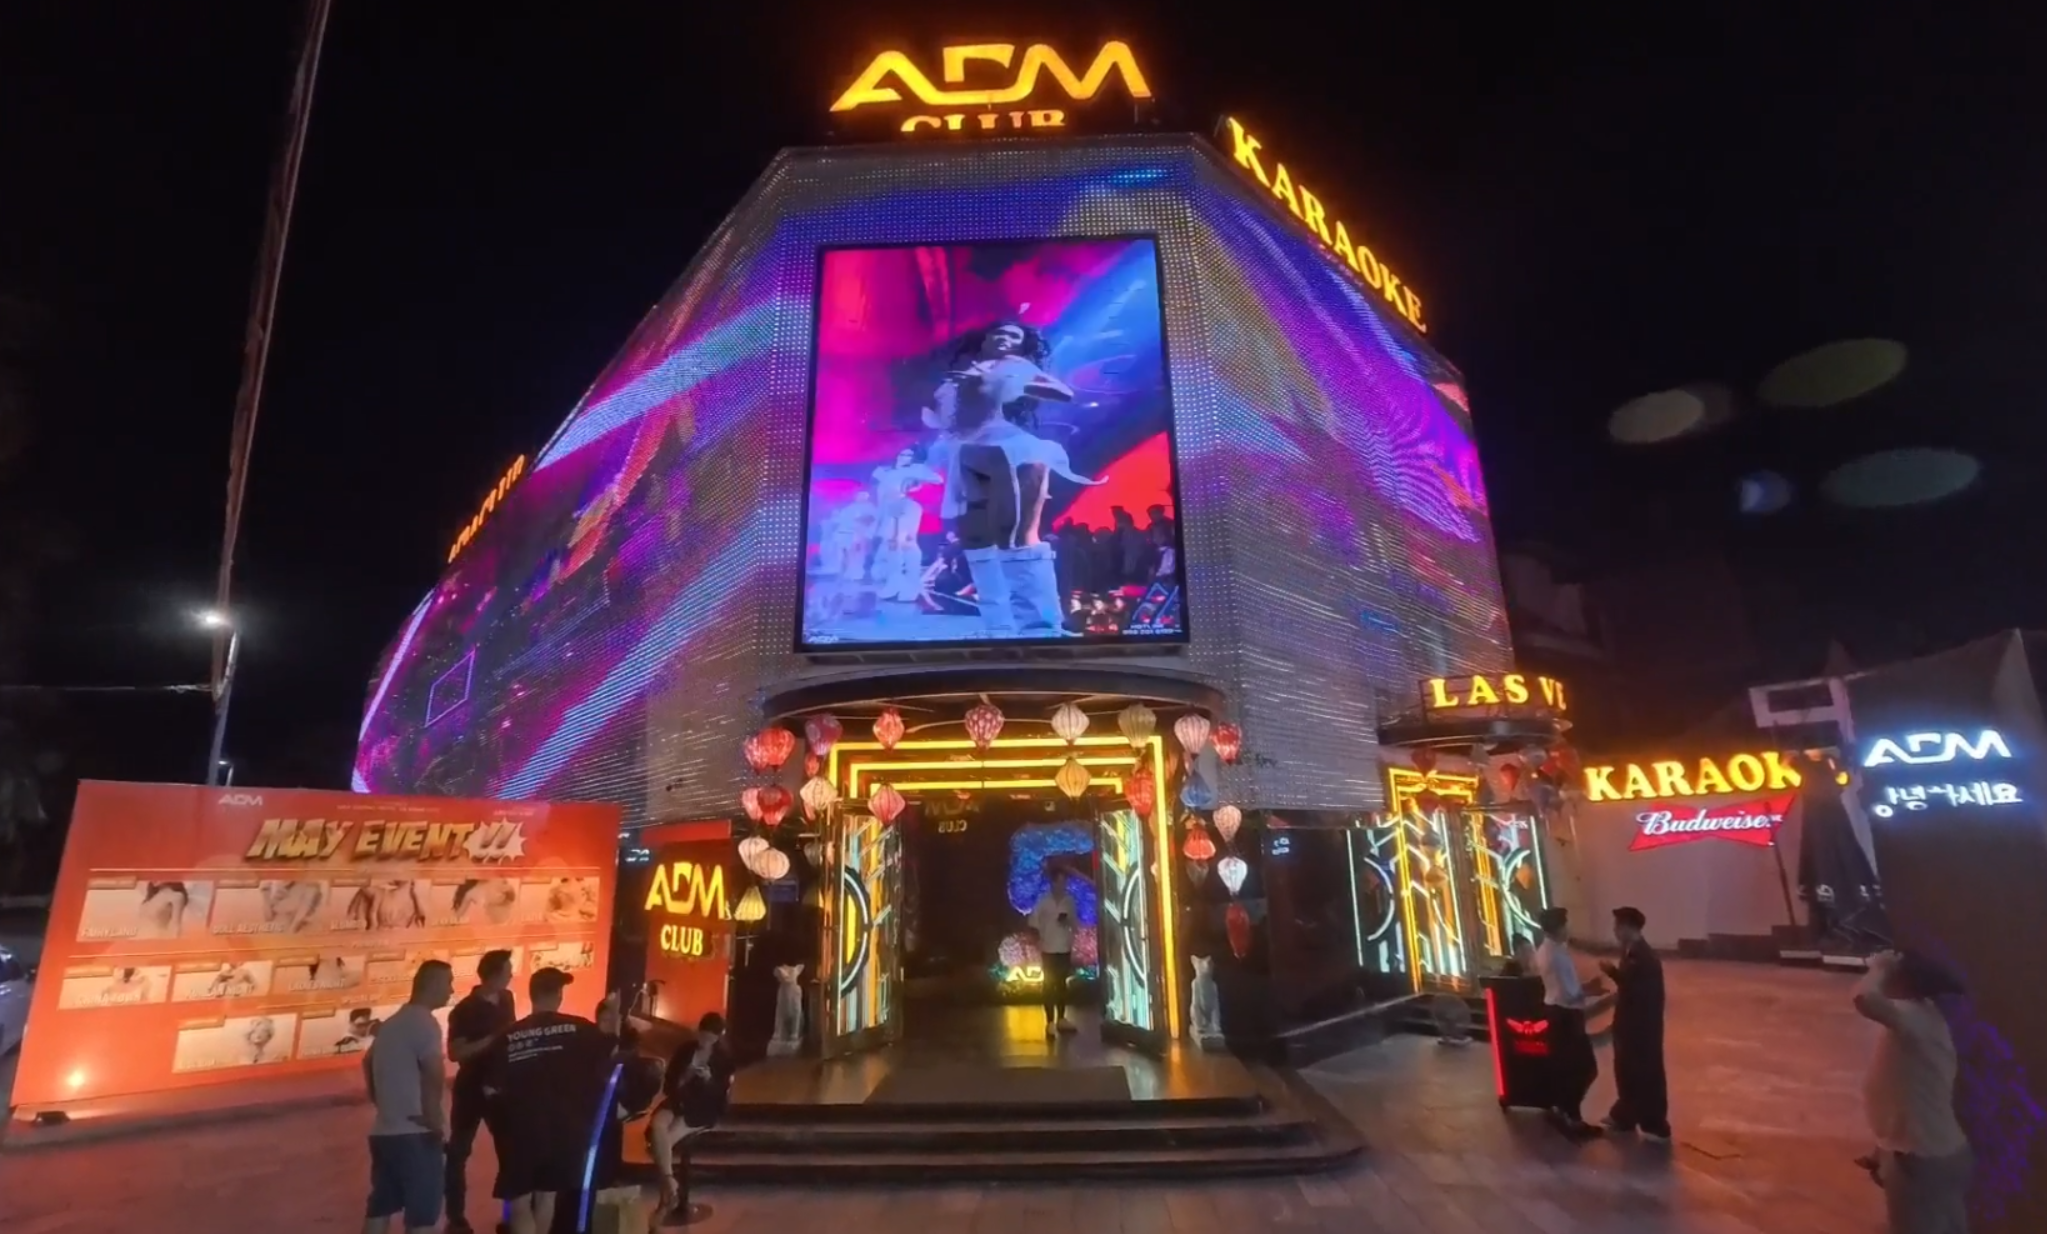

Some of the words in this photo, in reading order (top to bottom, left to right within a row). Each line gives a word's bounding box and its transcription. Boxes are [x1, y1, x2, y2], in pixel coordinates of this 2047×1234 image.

[829, 41, 1152, 111] ADM
[1228, 116, 1427, 333] KARAOKE
[1430, 674, 1529, 707] LAS
[1864, 730, 2012, 767] ADM
[1584, 752, 1848, 801] KARAOK
[218, 794, 263, 807] ADM
[246, 818, 354, 860] MAY
[644, 861, 726, 919] ADM
[660, 924, 704, 956] CLUB
[1006, 965, 1045, 982] AD
[506, 1026, 543, 1043] YOUNG
[543, 1023, 577, 1036] GREEN
